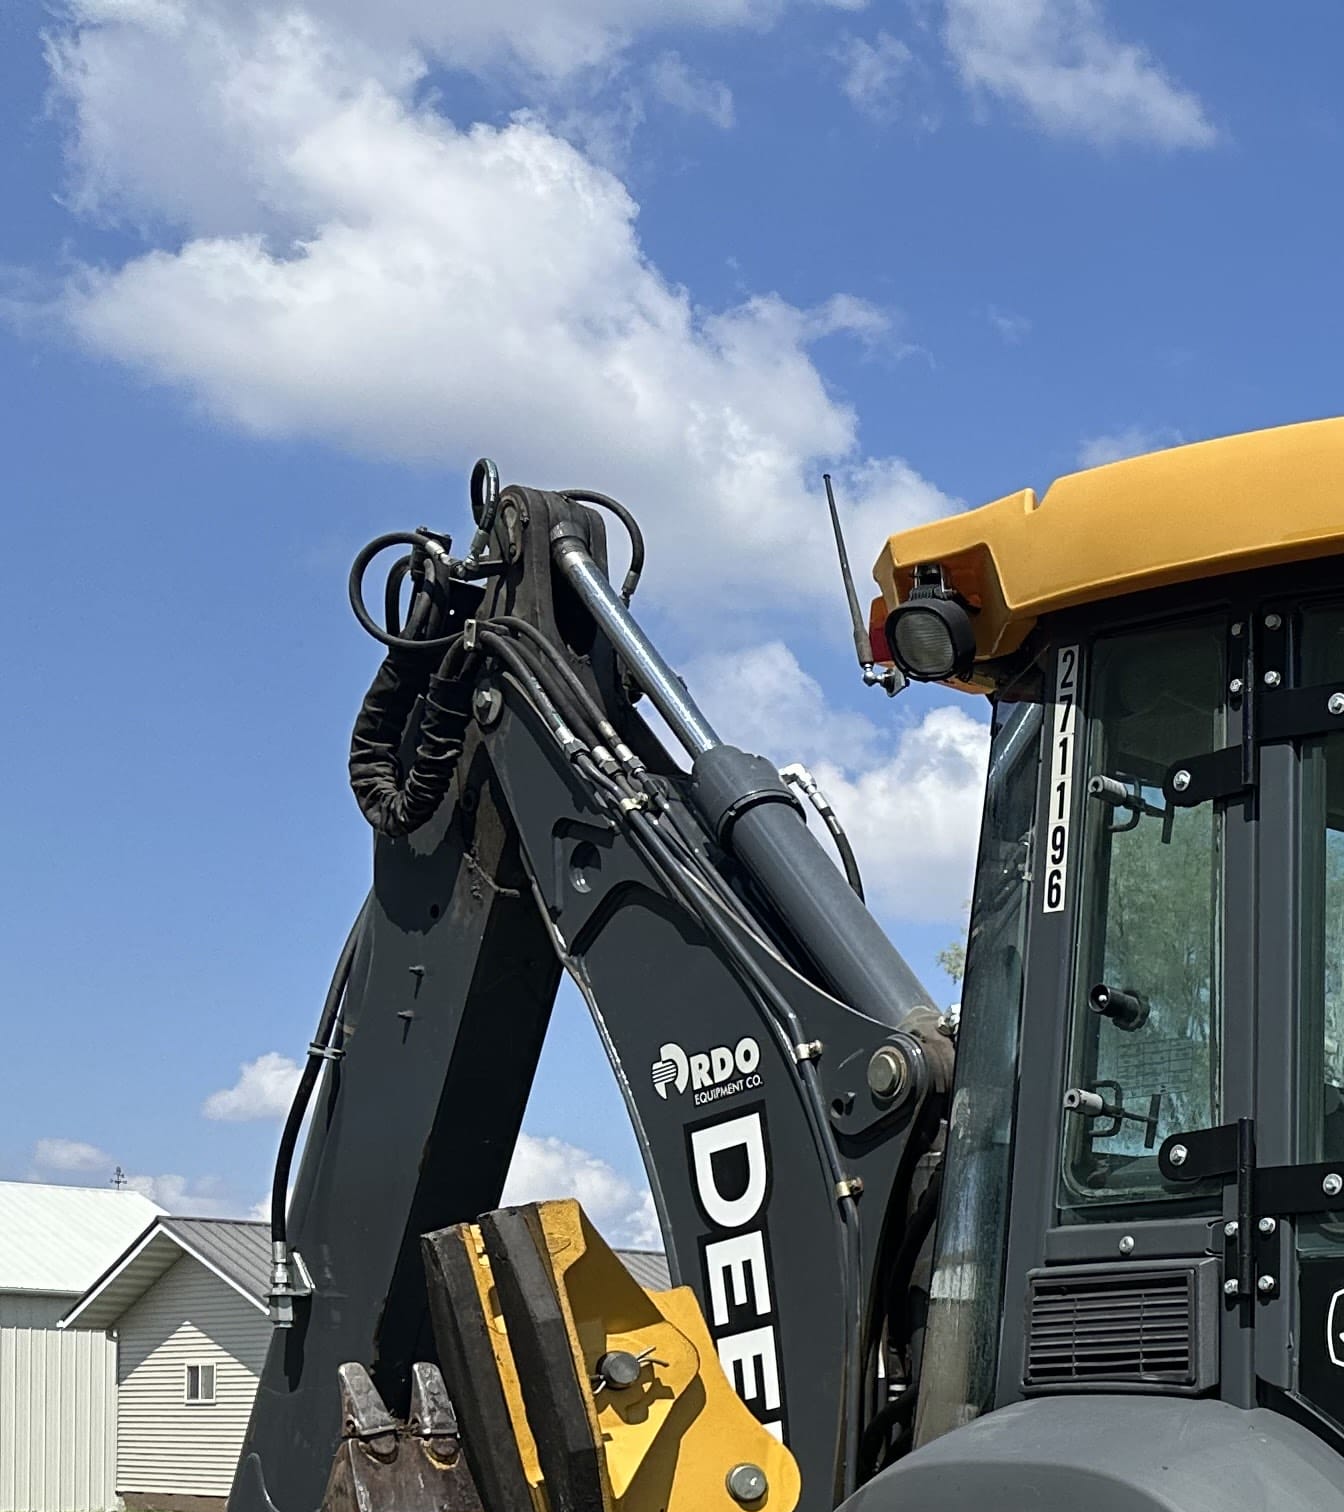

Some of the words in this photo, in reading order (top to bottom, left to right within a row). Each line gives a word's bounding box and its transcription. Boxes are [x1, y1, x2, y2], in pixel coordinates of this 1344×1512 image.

[1046, 649, 1076, 909] 271196
[694, 1079, 744, 1106] EQUIPMENT
[691, 1112, 788, 1450] DEE
